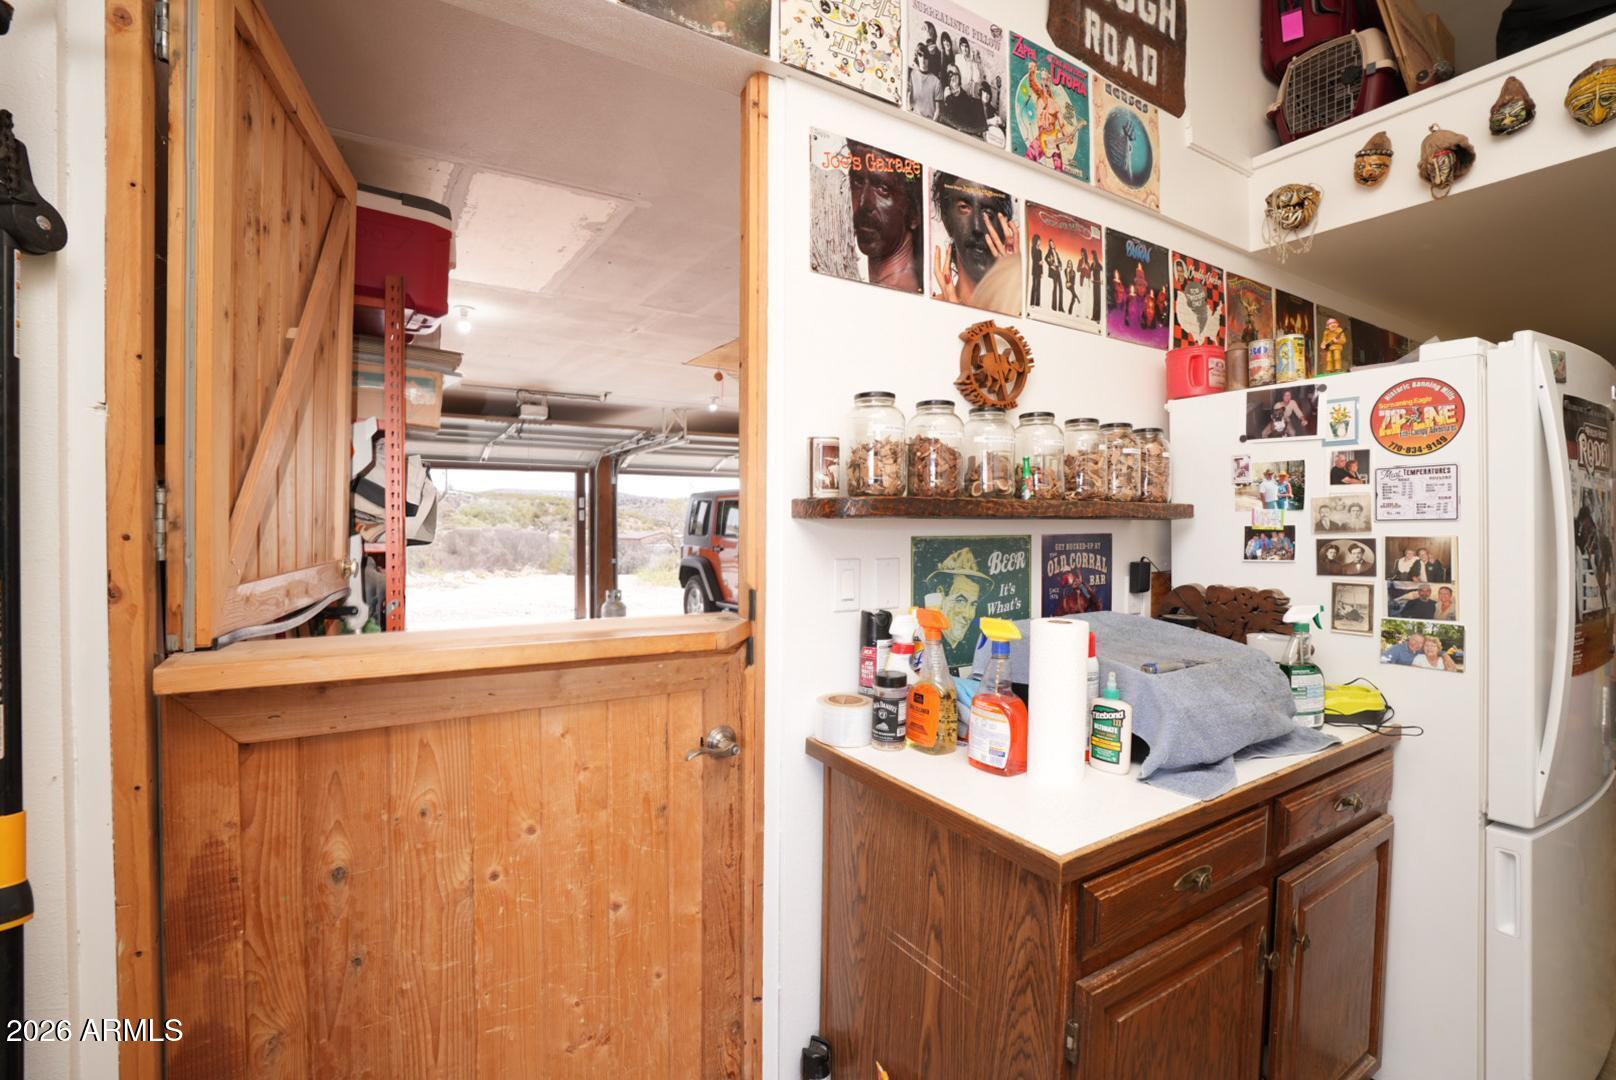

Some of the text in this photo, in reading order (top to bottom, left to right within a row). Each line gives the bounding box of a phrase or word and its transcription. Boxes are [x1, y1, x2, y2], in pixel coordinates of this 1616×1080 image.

[972, 28, 1001, 53] PILLOW
[1085, 8, 1157, 86] ROAD
[1051, 62, 1087, 97] UTOPIA
[822, 151, 921, 178] Joe's Garage
[1388, 435, 1449, 454] 770-834-9149
[1403, 467, 1451, 476] TEMPERATURES
[1047, 552, 1107, 577] OLD CORRAL
[999, 582, 1016, 597] It's
[1089, 575, 1106, 586] BAR
[987, 597, 1022, 616] What's
